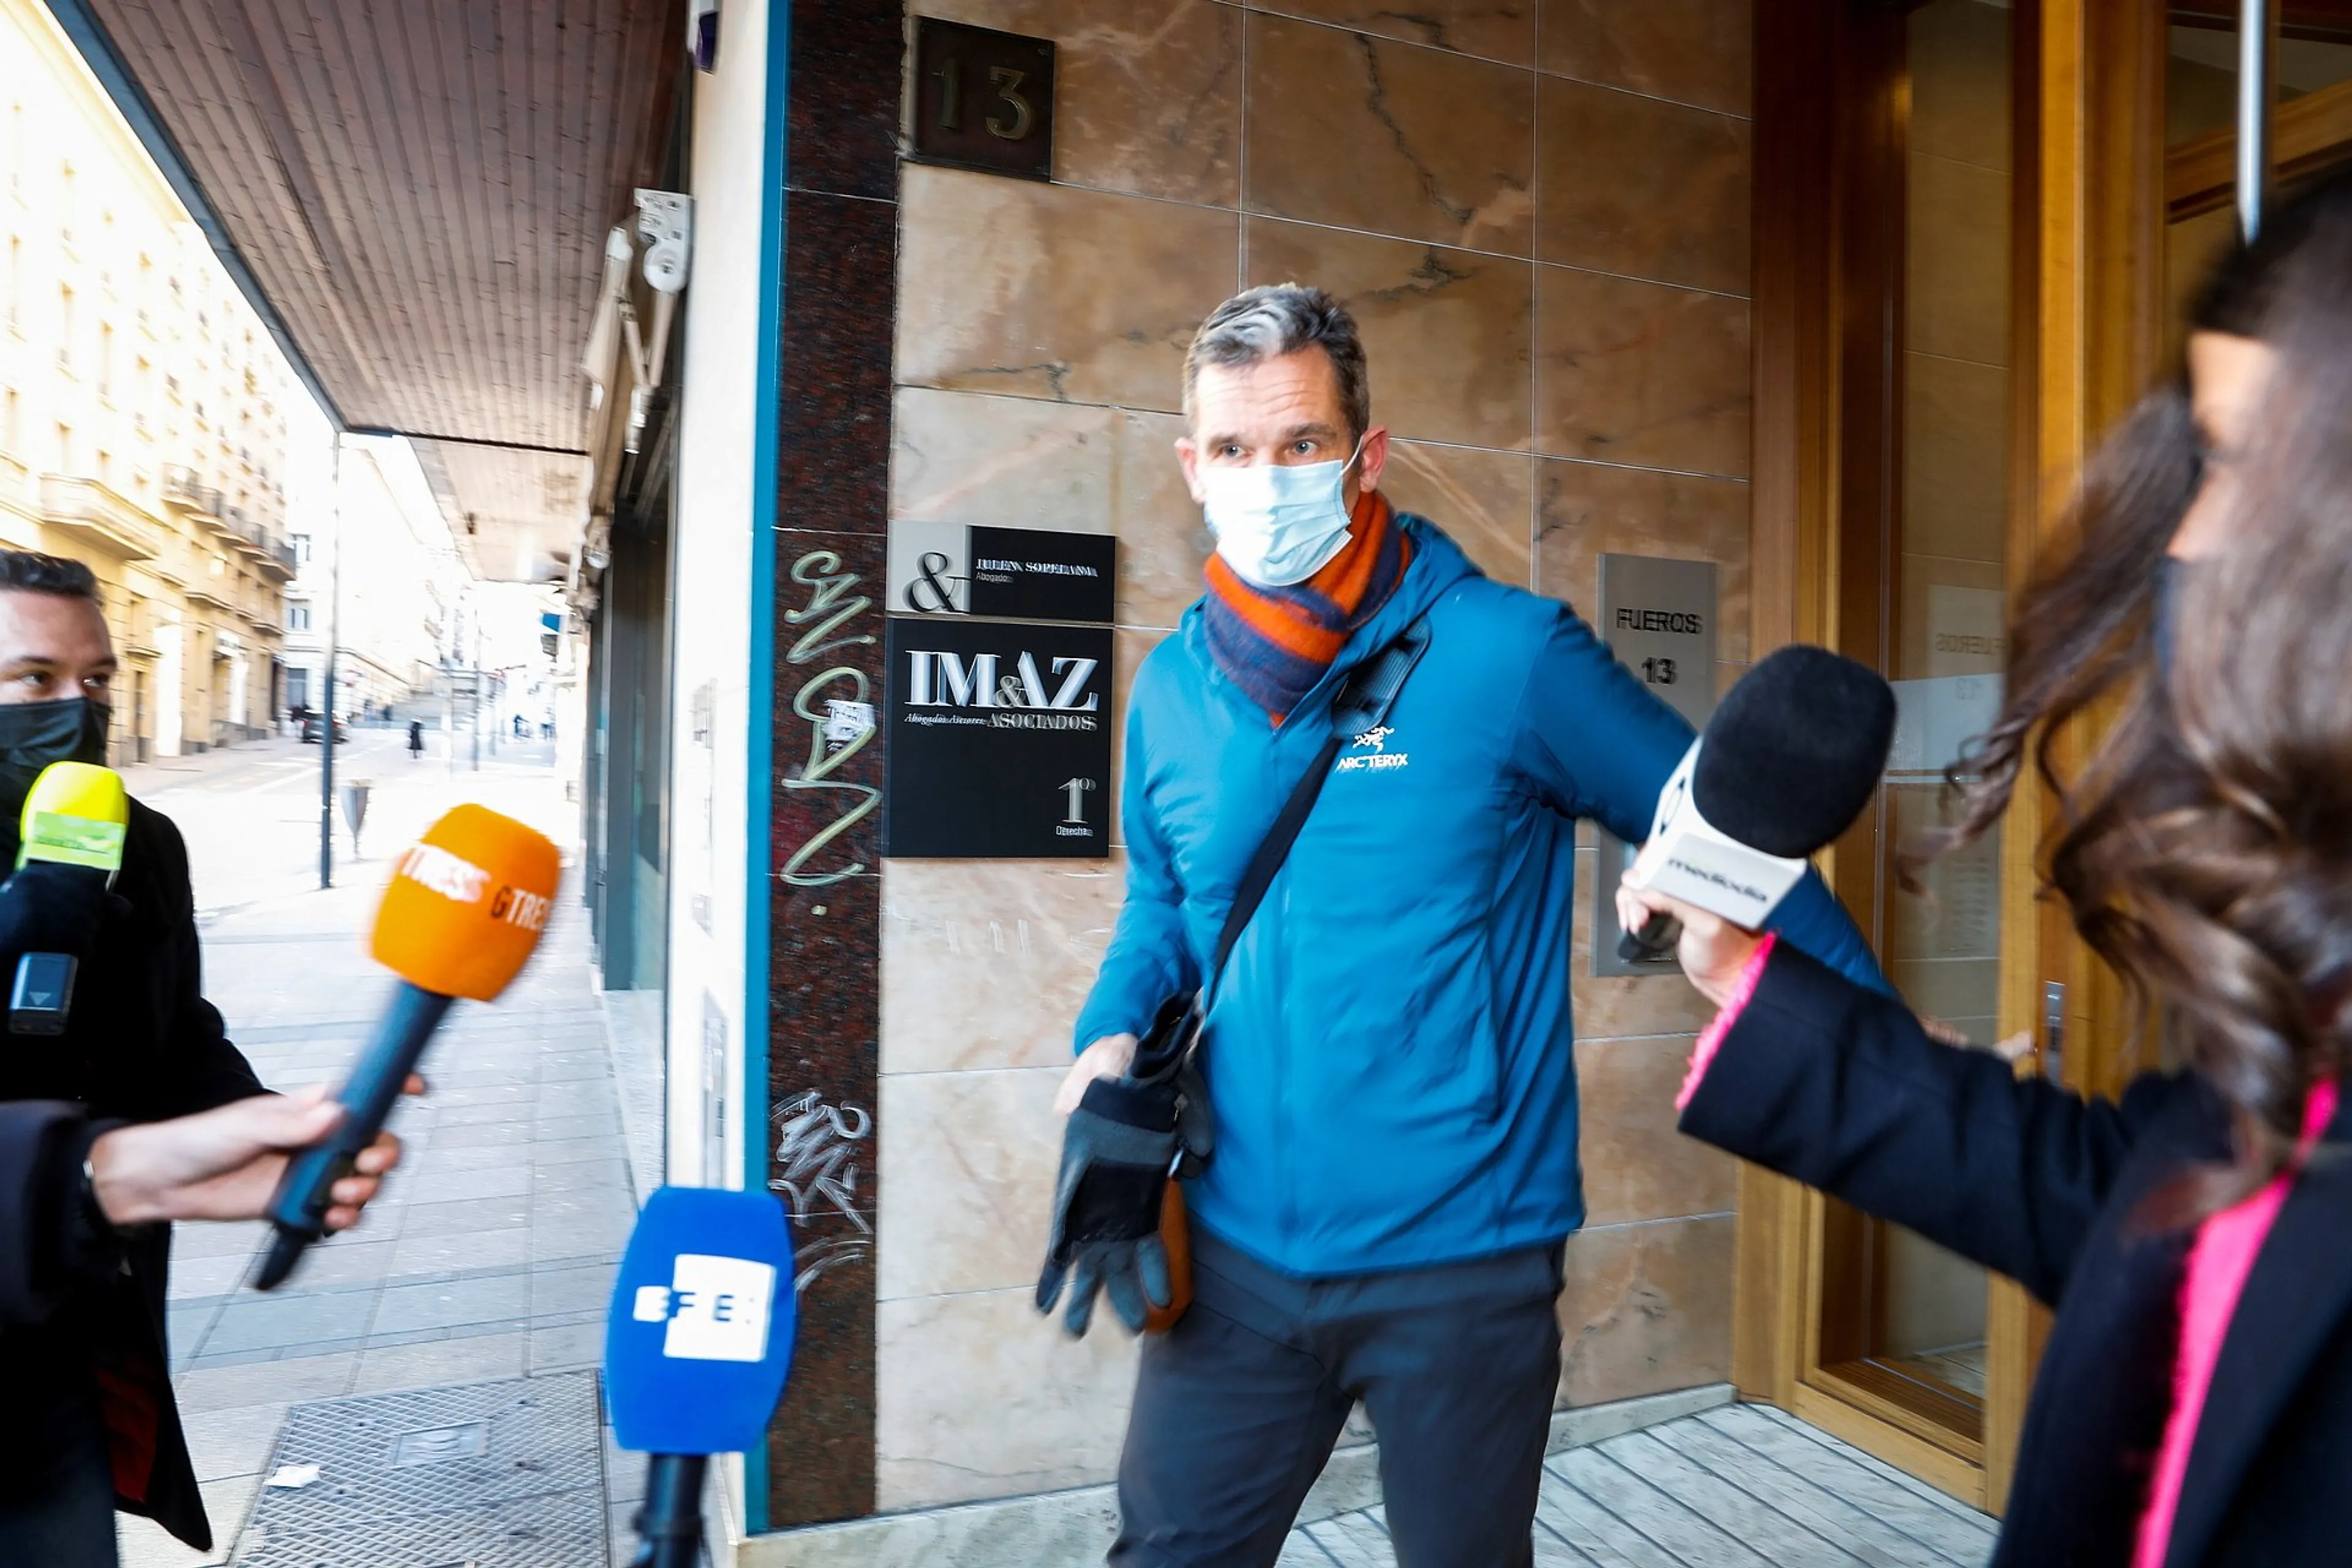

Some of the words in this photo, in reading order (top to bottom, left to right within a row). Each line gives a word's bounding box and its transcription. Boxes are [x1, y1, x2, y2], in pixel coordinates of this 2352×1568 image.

[932, 58, 1034, 141] 13
[1616, 607, 1703, 635] FUEROS
[1642, 657, 1678, 685] 13
[987, 713, 1097, 731] ASOCIADOS
